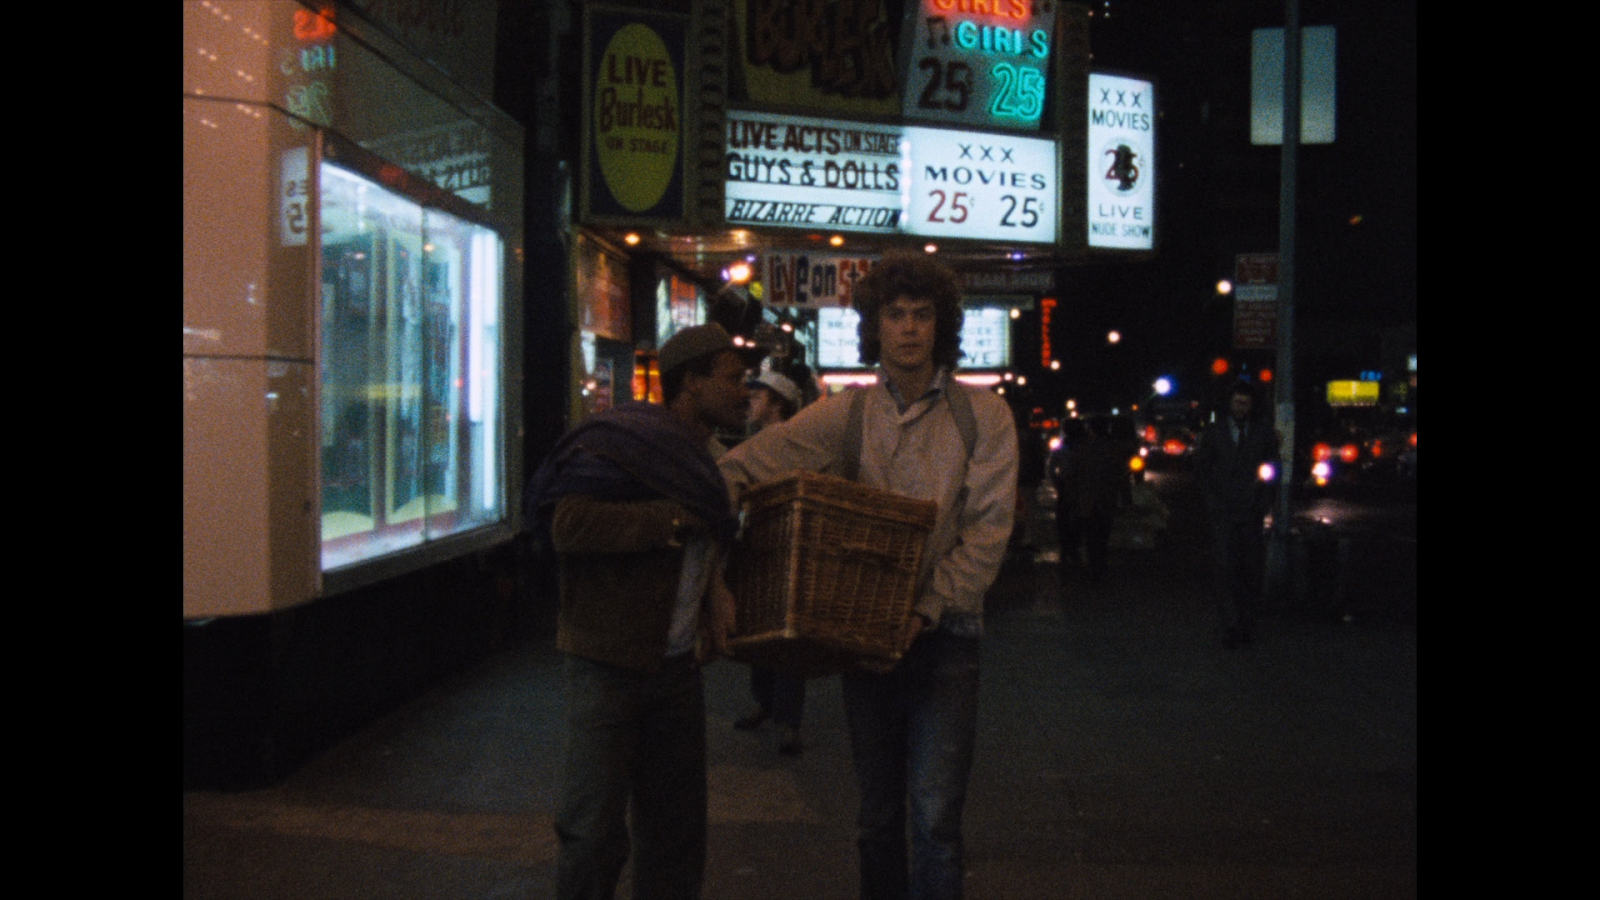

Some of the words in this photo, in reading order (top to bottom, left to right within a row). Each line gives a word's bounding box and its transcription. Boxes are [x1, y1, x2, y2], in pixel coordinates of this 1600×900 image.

[956, 20, 1049, 58] GIRLS
[608, 54, 667, 88] LIVE
[601, 86, 676, 132] Burlesk
[1091, 109, 1150, 131] MOVIES
[729, 120, 777, 150] LIVE
[784, 124, 840, 155] ACTS
[845, 129, 862, 151] ON
[865, 131, 899, 153] STAGE
[726, 152, 791, 185] GUYS
[801, 159, 815, 187] &
[824, 159, 899, 191] DOLLS
[925, 165, 1047, 190] MOVIES
[729, 199, 816, 224] BIZARRE
[827, 205, 900, 228] ACTION
[1099, 204, 1143, 220] LIVE
[1092, 223, 1117, 236] NUDE
[1122, 224, 1150, 238] SHOW
